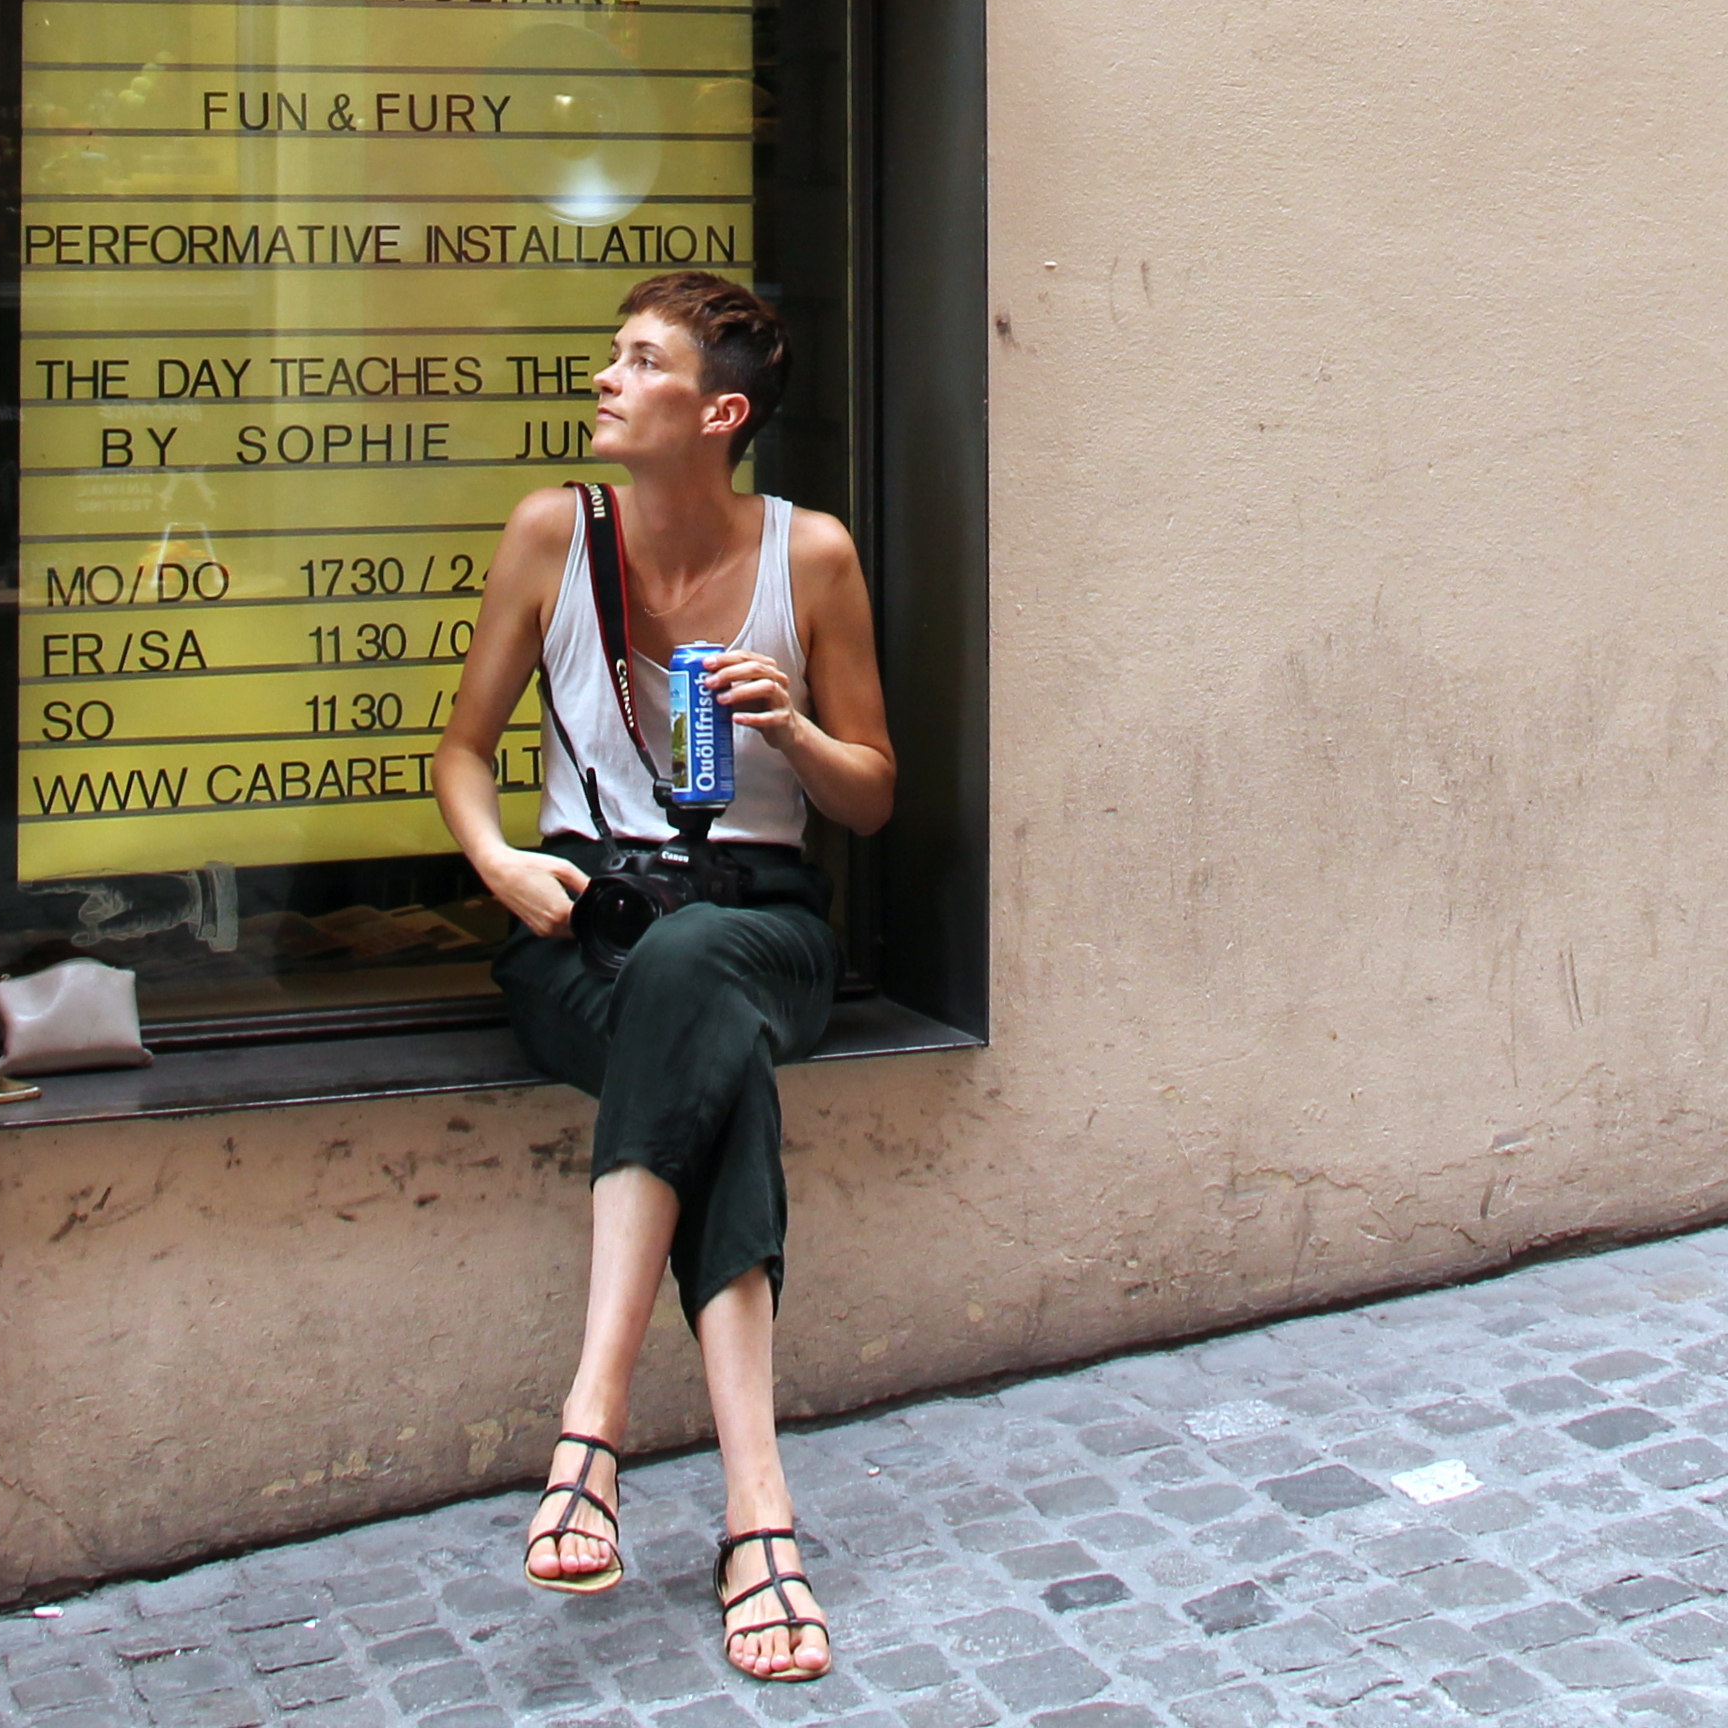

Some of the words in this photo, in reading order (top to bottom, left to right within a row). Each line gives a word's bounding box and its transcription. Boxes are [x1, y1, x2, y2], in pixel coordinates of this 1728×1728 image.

[203, 92, 309, 131] FUN
[327, 94, 357, 133] &
[375, 93, 512, 134] FURY
[25, 225, 402, 265] PERFORMATIVE
[425, 224, 735, 264] INSTALLATION
[36, 358, 130, 401] THE
[157, 357, 252, 399] DAY
[271, 356, 483, 397] TEACHES
[506, 356, 592, 394] THE
[101, 426, 179, 468] BY
[235, 422, 451, 463] SOPHIE
[47, 561, 230, 608] MO/DO
[300, 557, 404, 597] 1730
[450, 554, 489, 592] 2
[615, 659, 635, 728] Canon
[43, 700, 114, 742] SO
[34, 768, 188, 815] WWW
[661, 850, 689, 863] Canon
